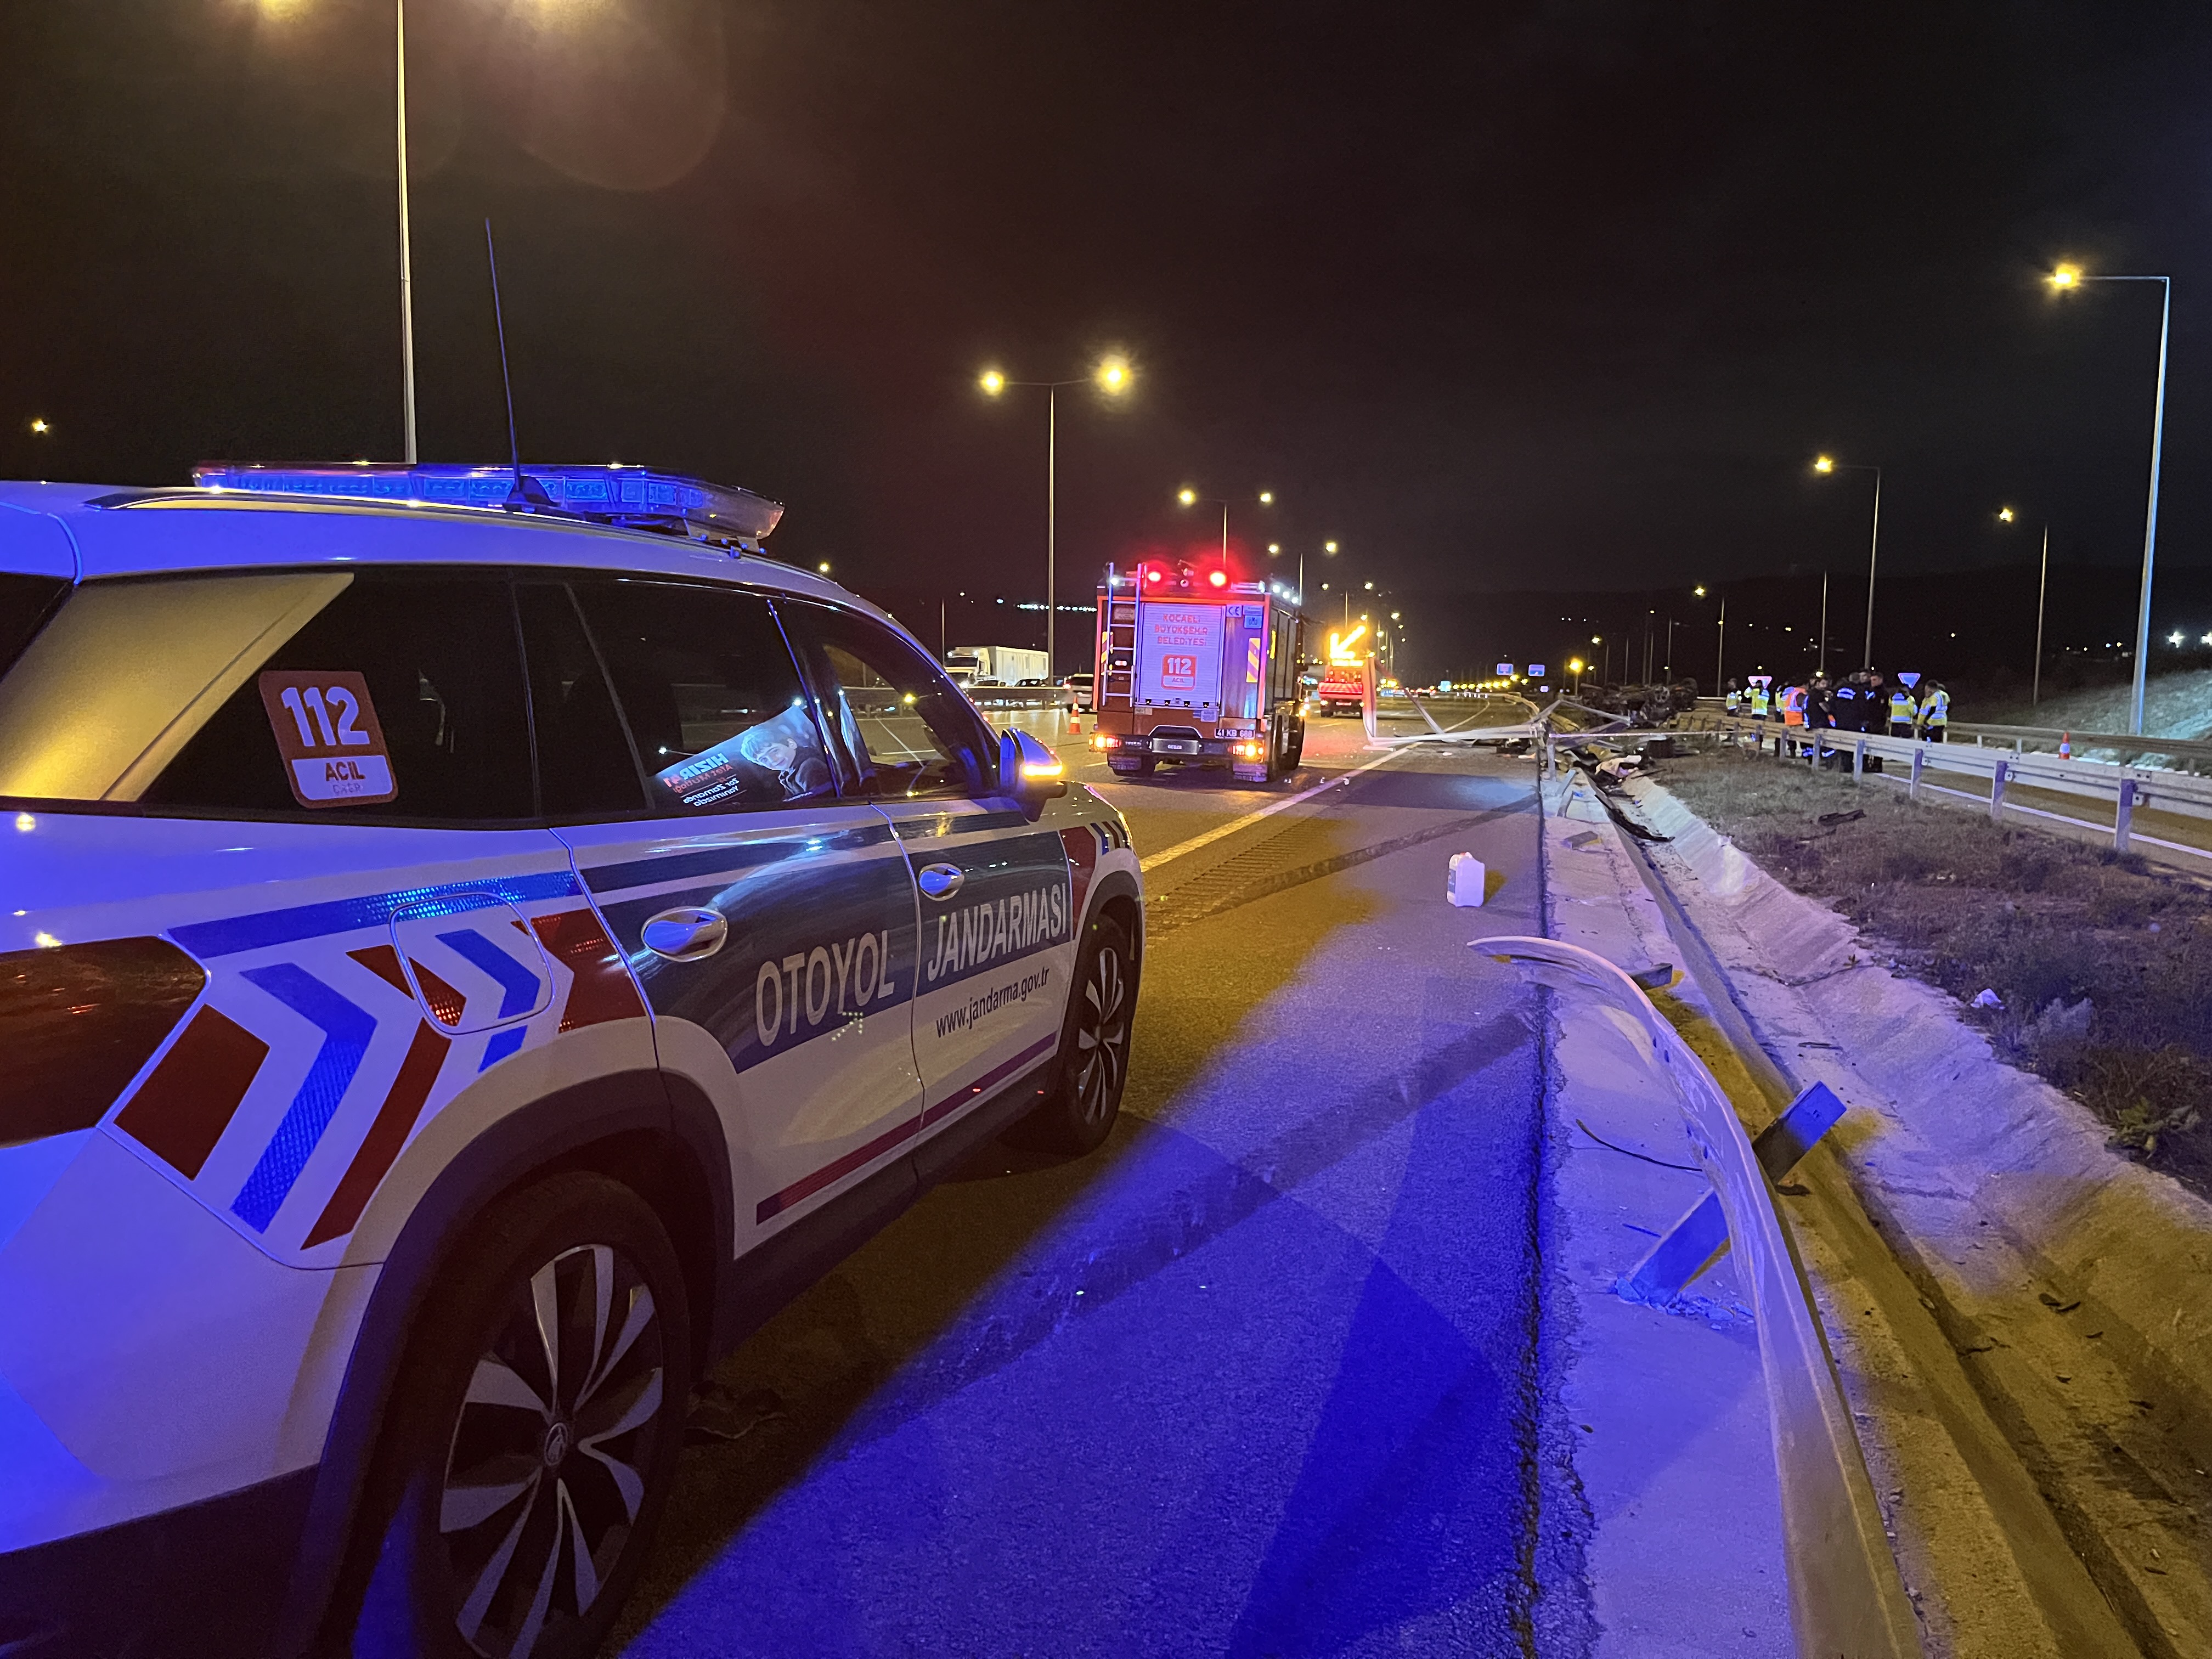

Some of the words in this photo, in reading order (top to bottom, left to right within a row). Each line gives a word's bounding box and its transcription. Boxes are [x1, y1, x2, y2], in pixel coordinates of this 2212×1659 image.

[1167, 657, 1192, 675] 112
[281, 686, 370, 747] 112
[756, 929, 895, 1047] OTOYOL
[928, 883, 1066, 982] JANDARMASI
[936, 966, 1049, 1038] www.jandarma.gov.tr
